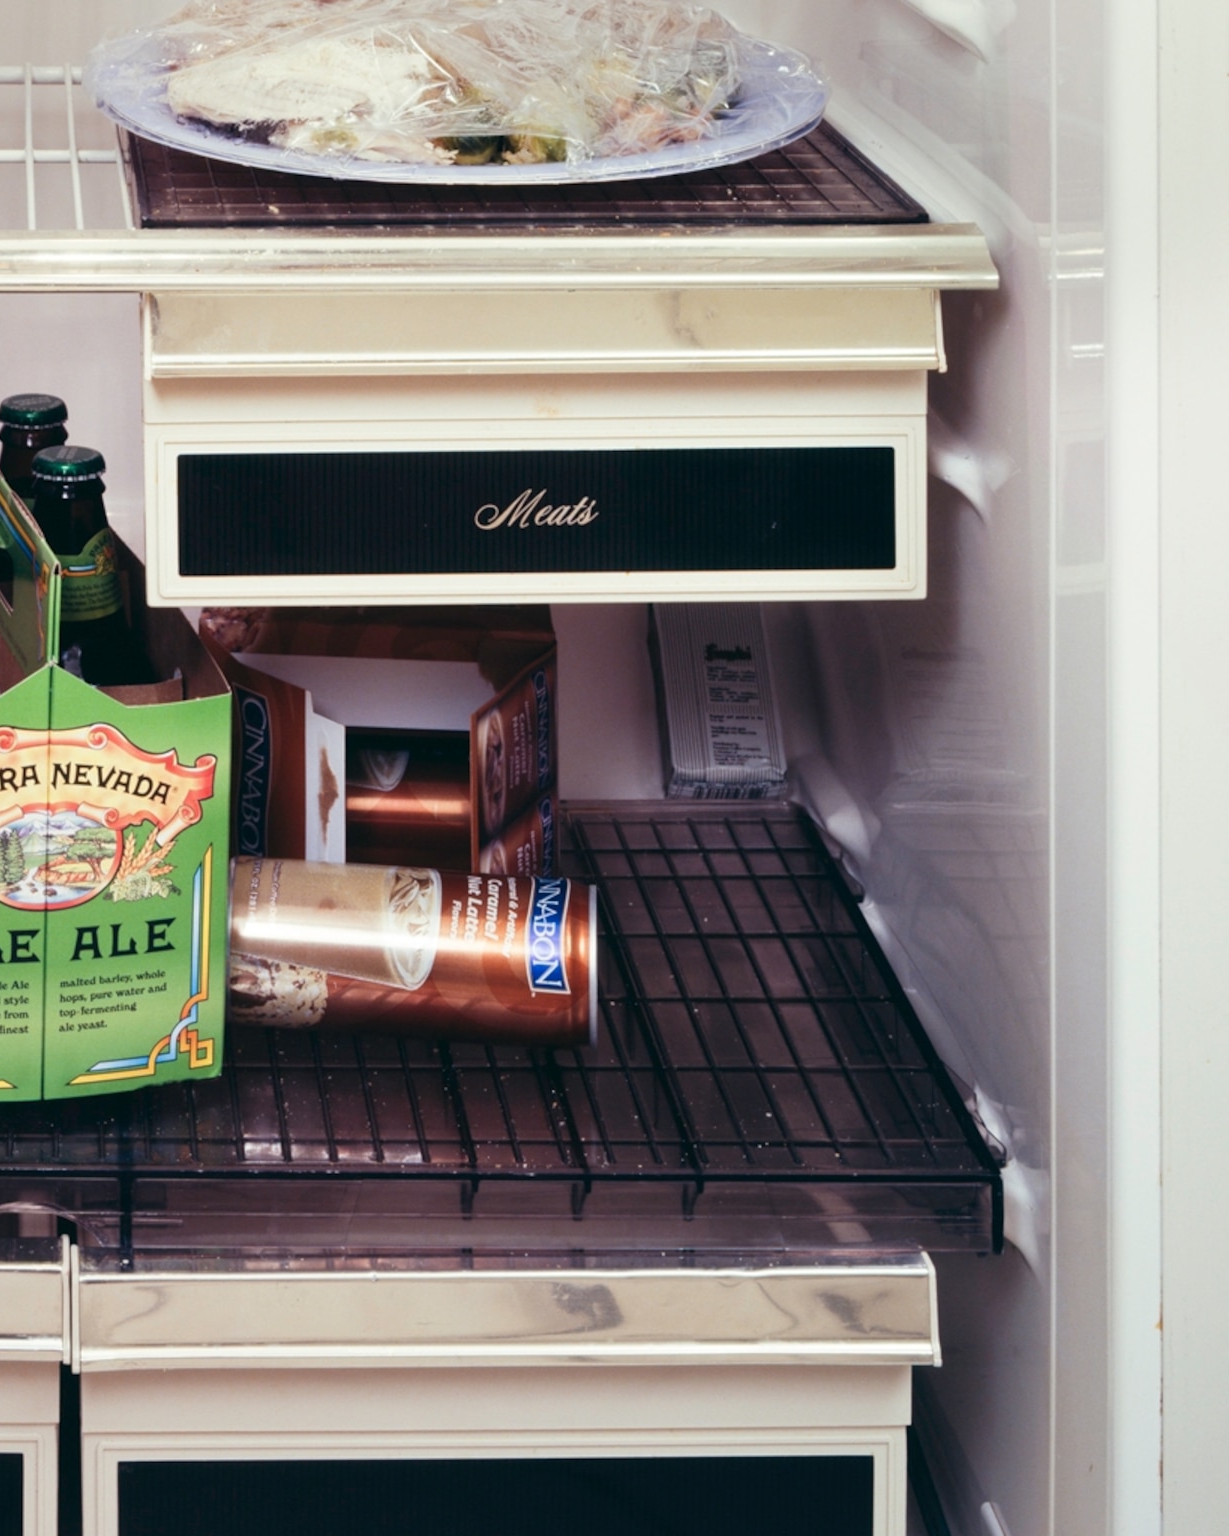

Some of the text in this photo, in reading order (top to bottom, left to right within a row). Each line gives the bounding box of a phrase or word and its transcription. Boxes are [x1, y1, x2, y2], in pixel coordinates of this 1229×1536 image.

[474, 488, 599, 531] Meats
[51, 762, 172, 806] NEVADA
[464, 875, 483, 943] Nut Latte
[484, 878, 503, 941] Caramel
[70, 917, 177, 961] ALE
[11, 980, 30, 990] Ale
[59, 969, 166, 988] malted barley, whole
[3, 995, 29, 1007] style
[59, 982, 168, 1004] hops, pure water and
[3, 1009, 29, 1020] from
[59, 1002, 138, 1019] top-fermenting
[58, 1019, 108, 1033] ale yeast.
